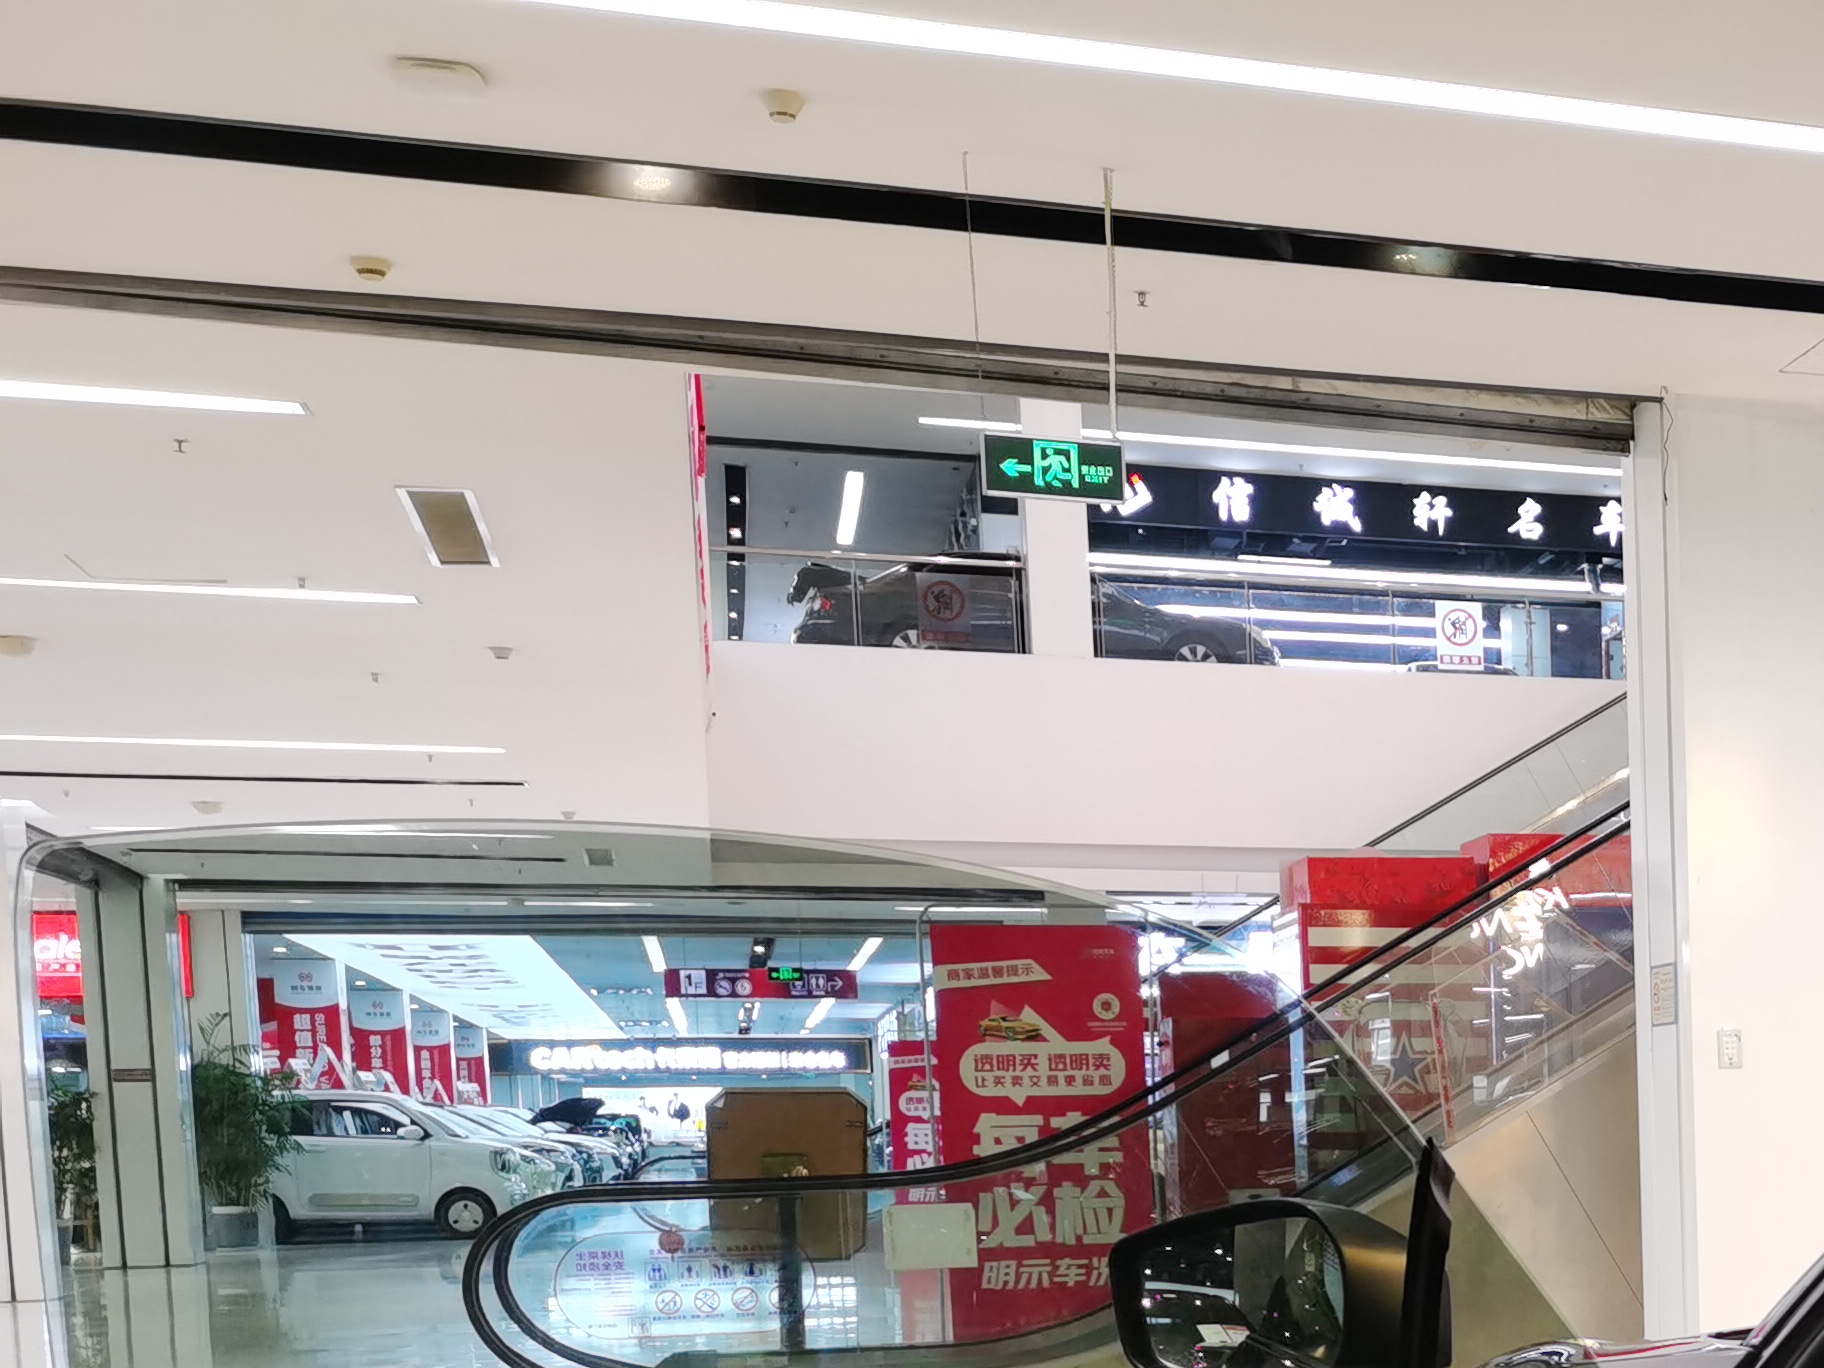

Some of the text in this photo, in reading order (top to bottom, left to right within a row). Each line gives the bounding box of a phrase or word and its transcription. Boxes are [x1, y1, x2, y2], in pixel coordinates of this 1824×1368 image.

[946, 963, 1035, 982] 商家温馨提示
[974, 1053, 1112, 1072] 透明买 透明卖
[978, 1179, 1128, 1248] 必检
